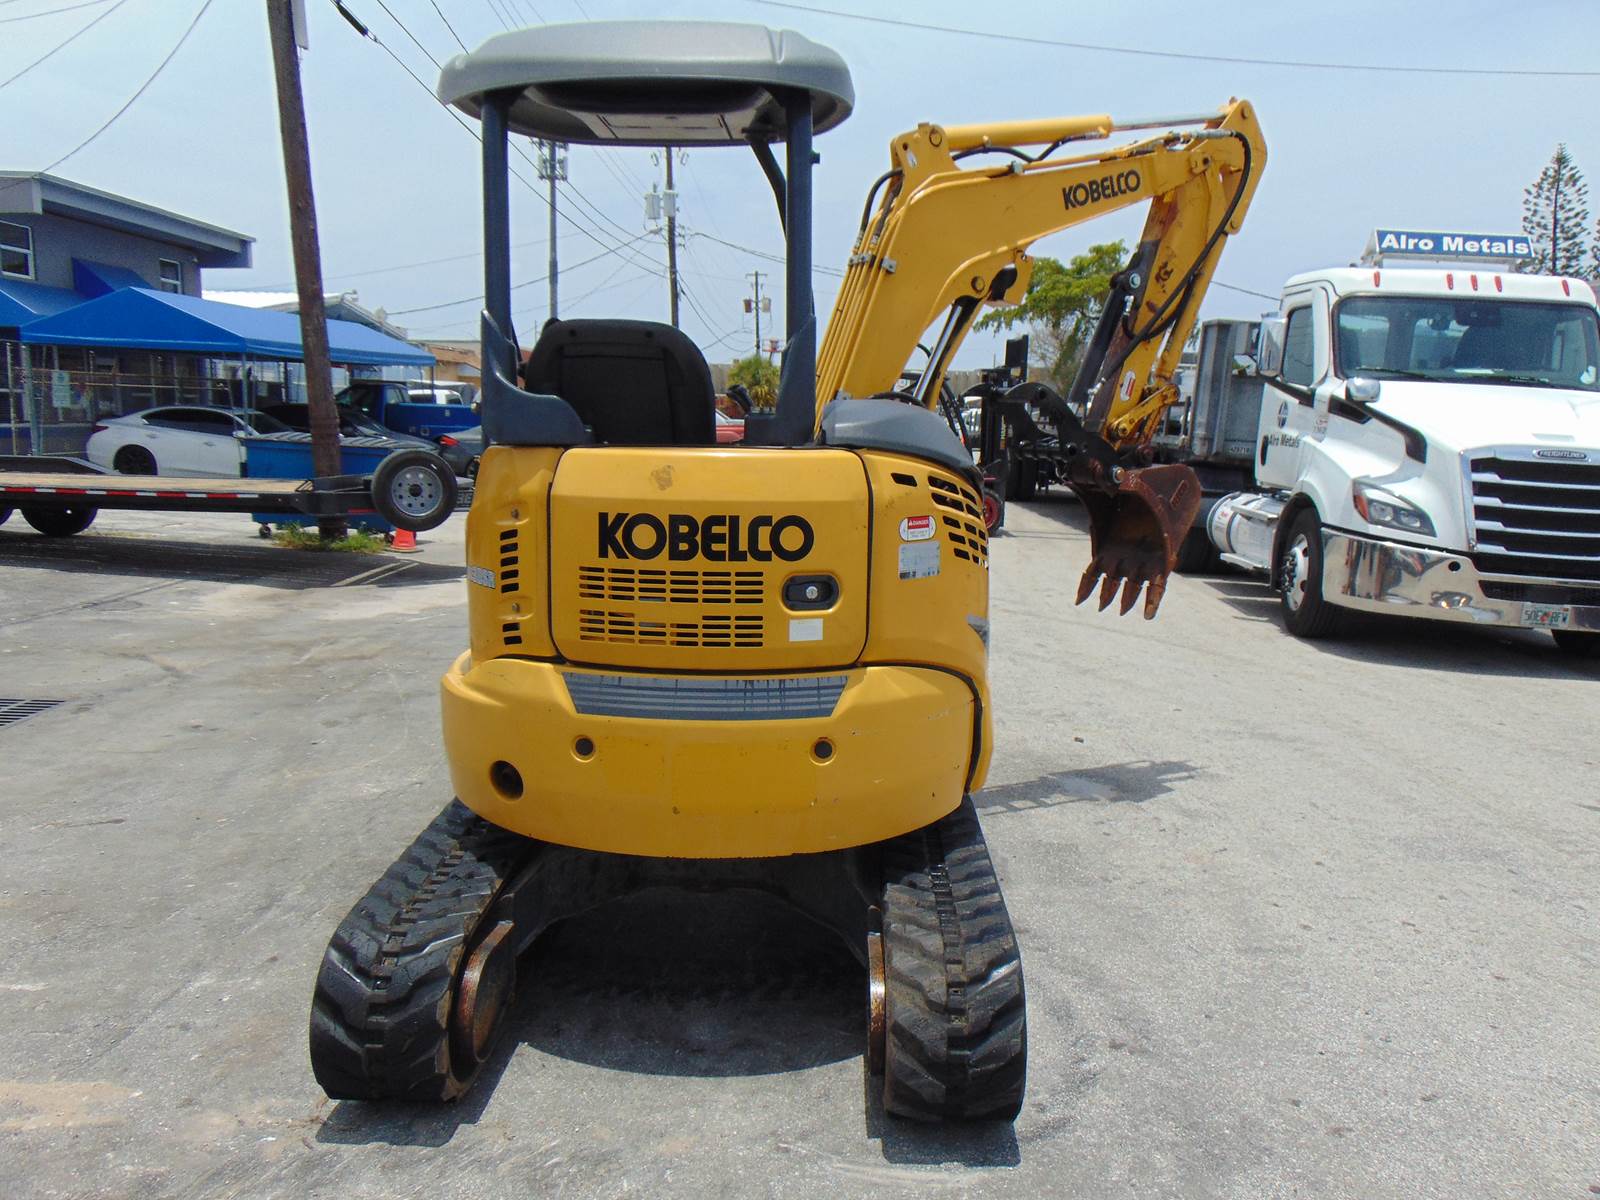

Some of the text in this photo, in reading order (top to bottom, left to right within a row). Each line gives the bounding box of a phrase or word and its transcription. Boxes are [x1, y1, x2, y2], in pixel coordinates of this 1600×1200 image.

[1062, 169, 1141, 210] KOBELCO
[1381, 233, 1529, 254] Alro Metals
[1281, 434, 1300, 448] Metals
[598, 512, 814, 562] KOBELCO
